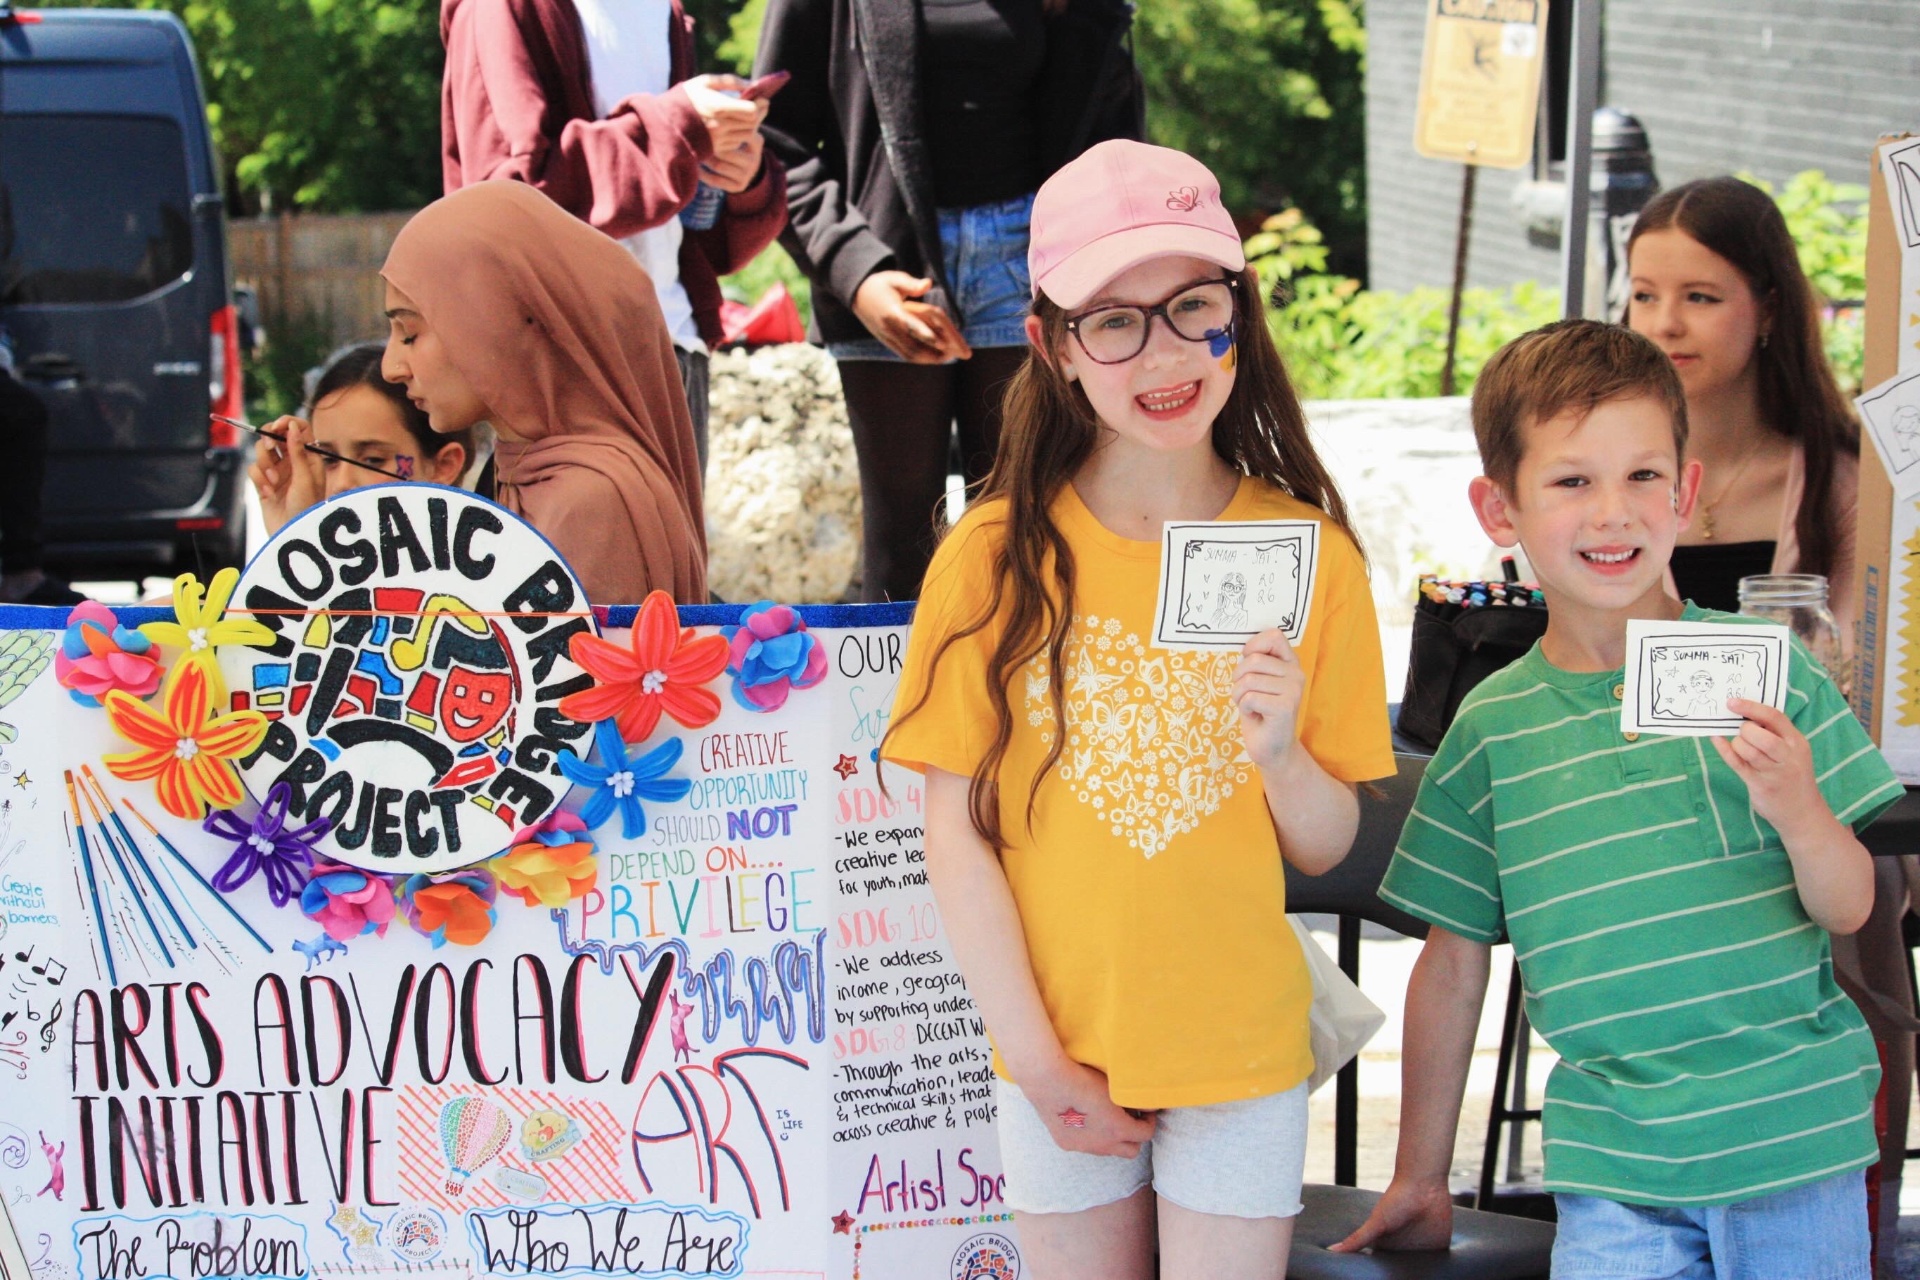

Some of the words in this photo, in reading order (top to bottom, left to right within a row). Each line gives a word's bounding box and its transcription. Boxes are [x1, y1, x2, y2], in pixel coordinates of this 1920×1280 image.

[245, 496, 504, 657] MOSAIC
[839, 633, 903, 678] OUR
[1673, 650, 1710, 662] SUMMA
[1721, 653, 1745, 668] SAT!
[700, 731, 793, 773] CREATIVE
[239, 719, 466, 859] PROJECT
[690, 770, 808, 810] OPPORTUNITY
[835, 786, 902, 825] SDG
[907, 784, 921, 814] 4
[651, 814, 721, 846] SHOULD
[726, 804, 798, 841] NOT
[875, 827, 925, 846] expan
[610, 850, 696, 882] DEPEND
[835, 851, 898, 874] creative
[2, 874, 44, 897] Create
[839, 879, 859, 895] for
[581, 869, 822, 941] PRIVILEGE
[836, 906, 901, 949] SDG
[908, 902, 938, 943] 10
[880, 949, 943, 968] address
[72, 981, 226, 1092] ARTS
[253, 952, 676, 1088] ADVOCACY
[834, 1008, 854, 1027] by
[859, 1000, 930, 1022] supporting
[933, 996, 978, 1014] under
[833, 1025, 890, 1060] SDG
[916, 1018, 967, 1045] DECENT
[969, 1015, 987, 1037] W
[911, 1053, 942, 1071] the
[948, 1046, 988, 1064] arts,
[833, 1076, 954, 1104] communication,
[836, 1105, 849, 1122] &
[854, 1096, 916, 1120] technical
[921, 1092, 956, 1108] skills
[960, 1084, 992, 1102] that
[776, 1109, 790, 1119] IS
[782, 1119, 803, 1130] LIFE
[833, 1124, 872, 1143] across
[876, 1113, 938, 1137] creative
[945, 1107, 956, 1129] &
[71, 1087, 400, 1212] INITIATIVE
[530, 1137, 566, 1158] CRAFTING
[631, 1047, 809, 1220] ART
[857, 1148, 947, 1215] Artist
[395, 1213, 416, 1233] MOSAIC
[418, 1213, 439, 1230] BRIDGE
[469, 1209, 569, 1274] Who
[571, 1207, 644, 1274] We
[661, 1211, 736, 1275] Are
[79, 1220, 147, 1280] The
[156, 1217, 305, 1278] Problem
[404, 1247, 432, 1257] PROJECT
[955, 1237, 985, 1267] MOSAIC
[988, 1237, 1016, 1262] BRIDGE
